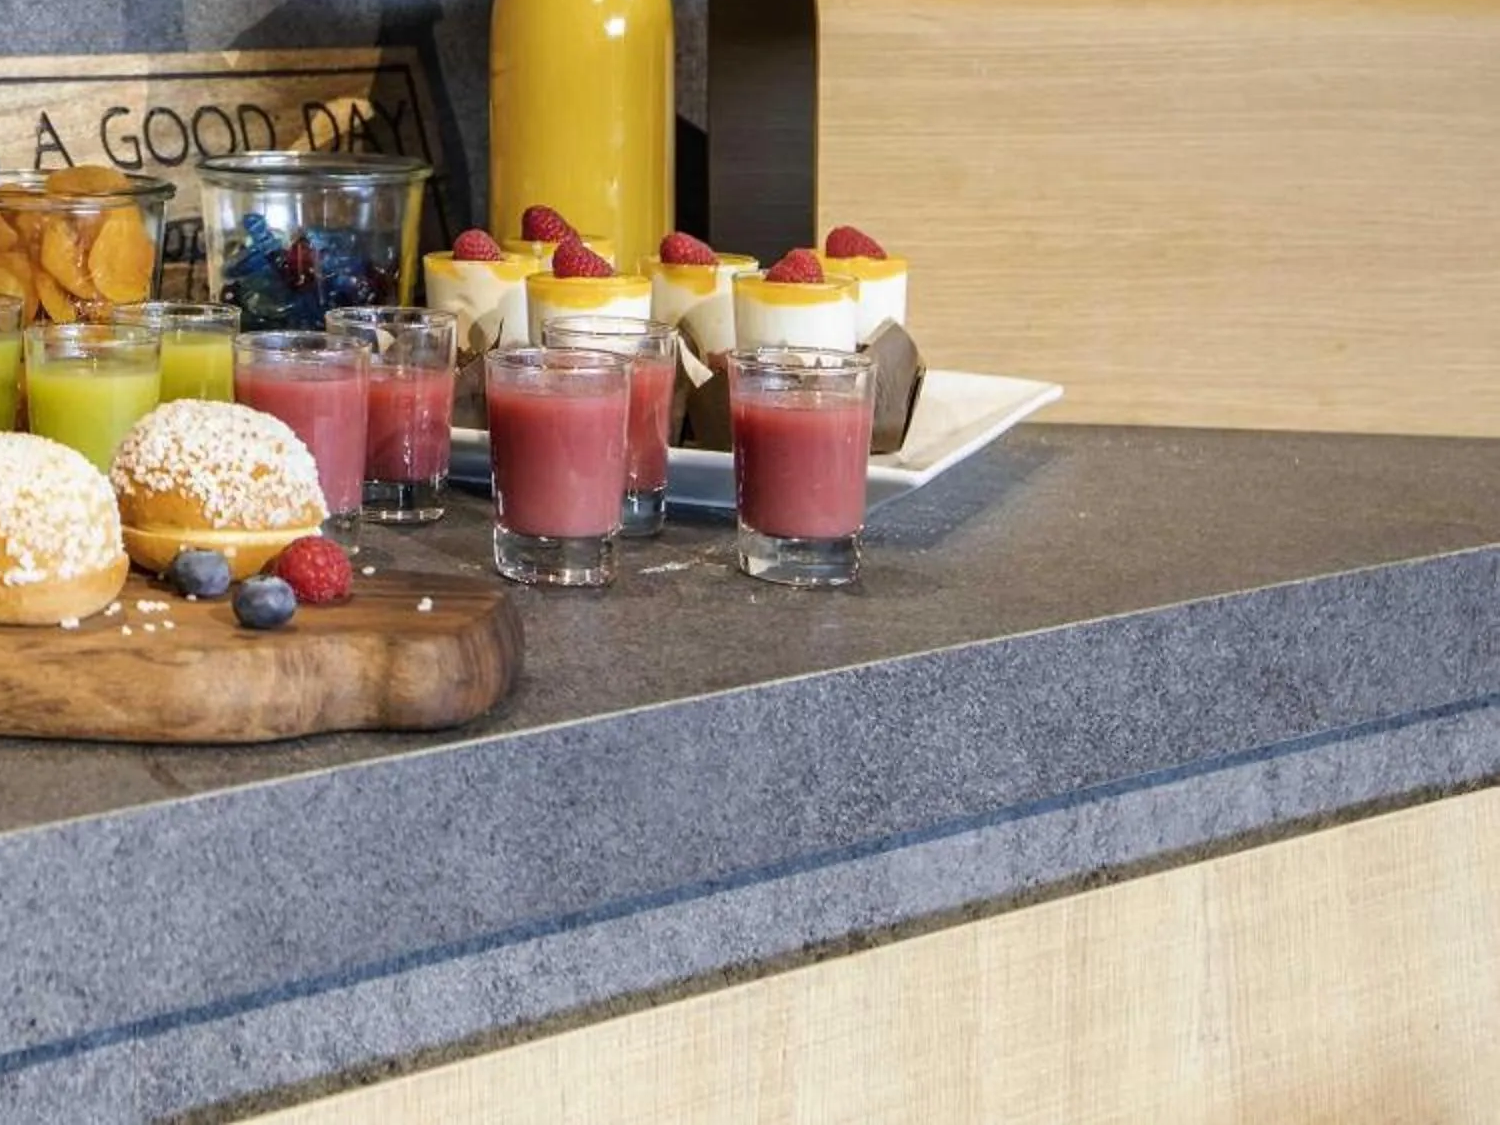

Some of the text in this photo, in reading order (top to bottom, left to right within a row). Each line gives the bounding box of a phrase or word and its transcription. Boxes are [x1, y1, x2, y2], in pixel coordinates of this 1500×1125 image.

[33, 110, 76, 172] A
[100, 104, 277, 170] GOOD
[302, 101, 409, 158] DAY
